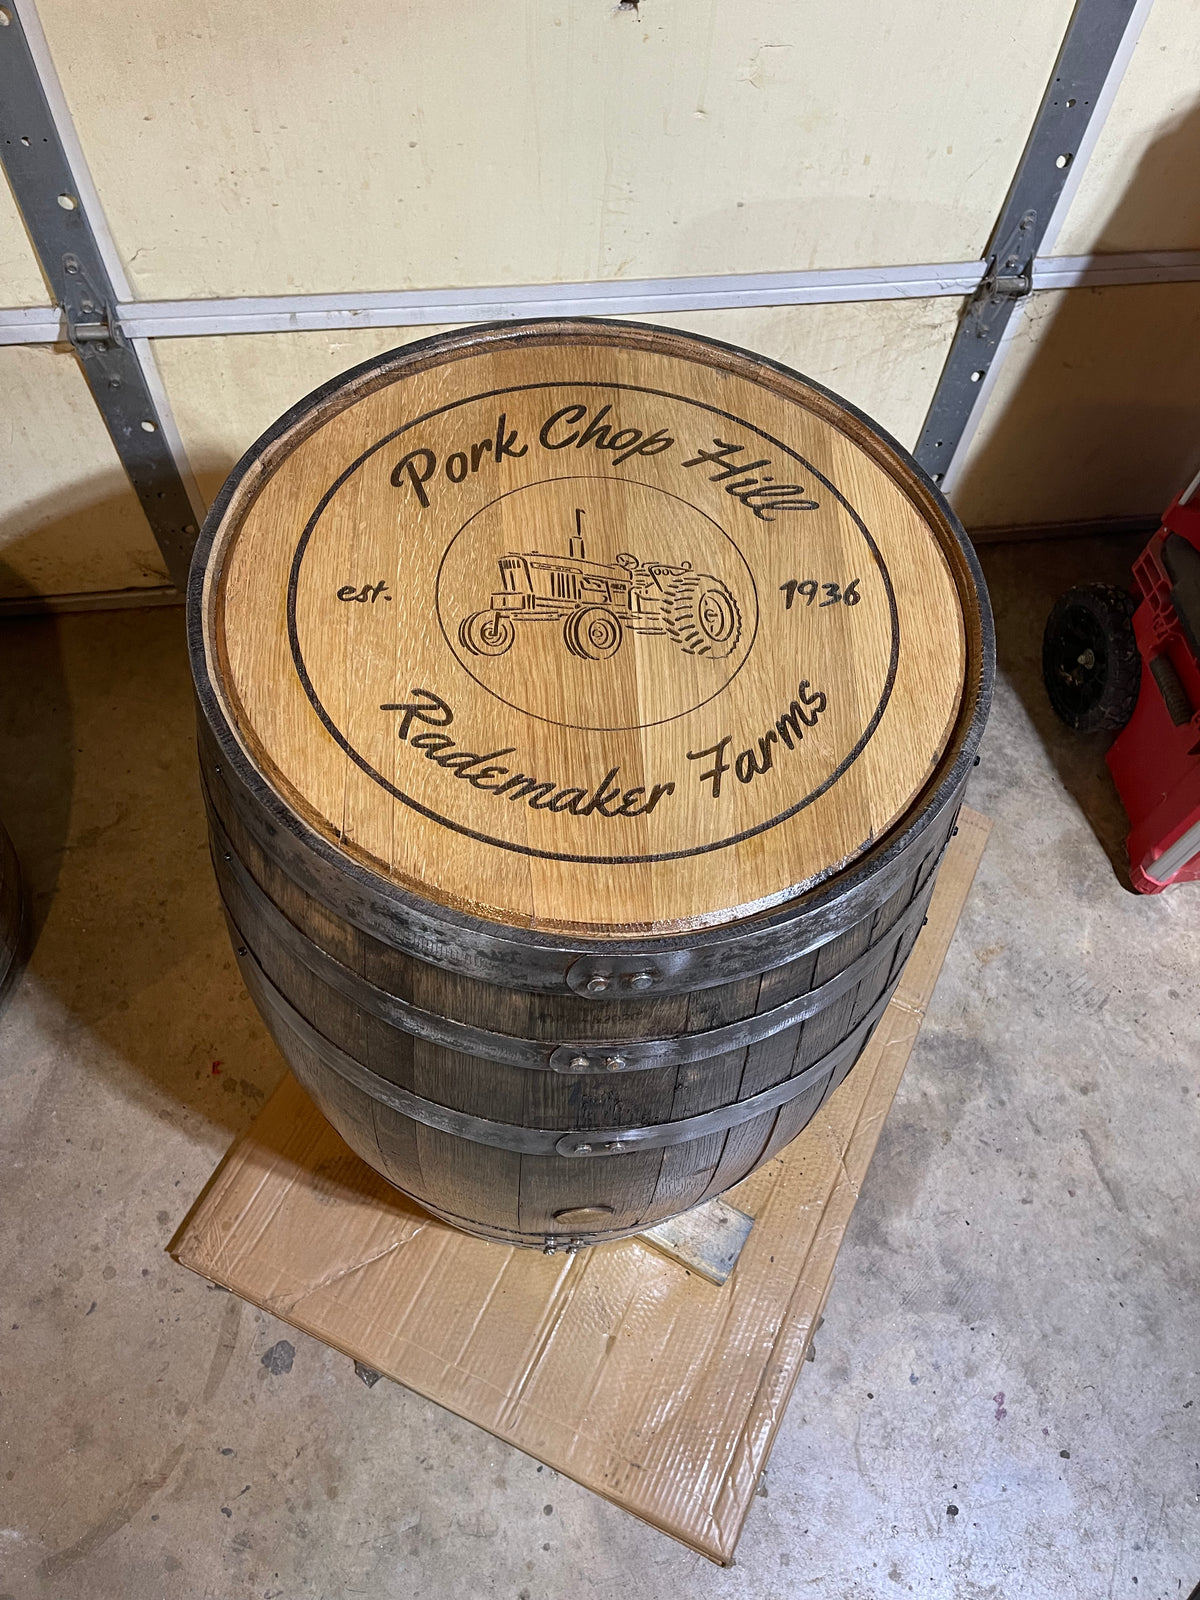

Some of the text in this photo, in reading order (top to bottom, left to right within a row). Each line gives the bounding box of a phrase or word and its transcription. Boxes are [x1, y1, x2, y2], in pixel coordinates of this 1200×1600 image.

[390, 404, 820, 522] Pork Chop Hill
[336, 580, 392, 603] est.
[779, 578, 861, 610] 1936
[380, 680, 828, 817] Rademaker Farms
